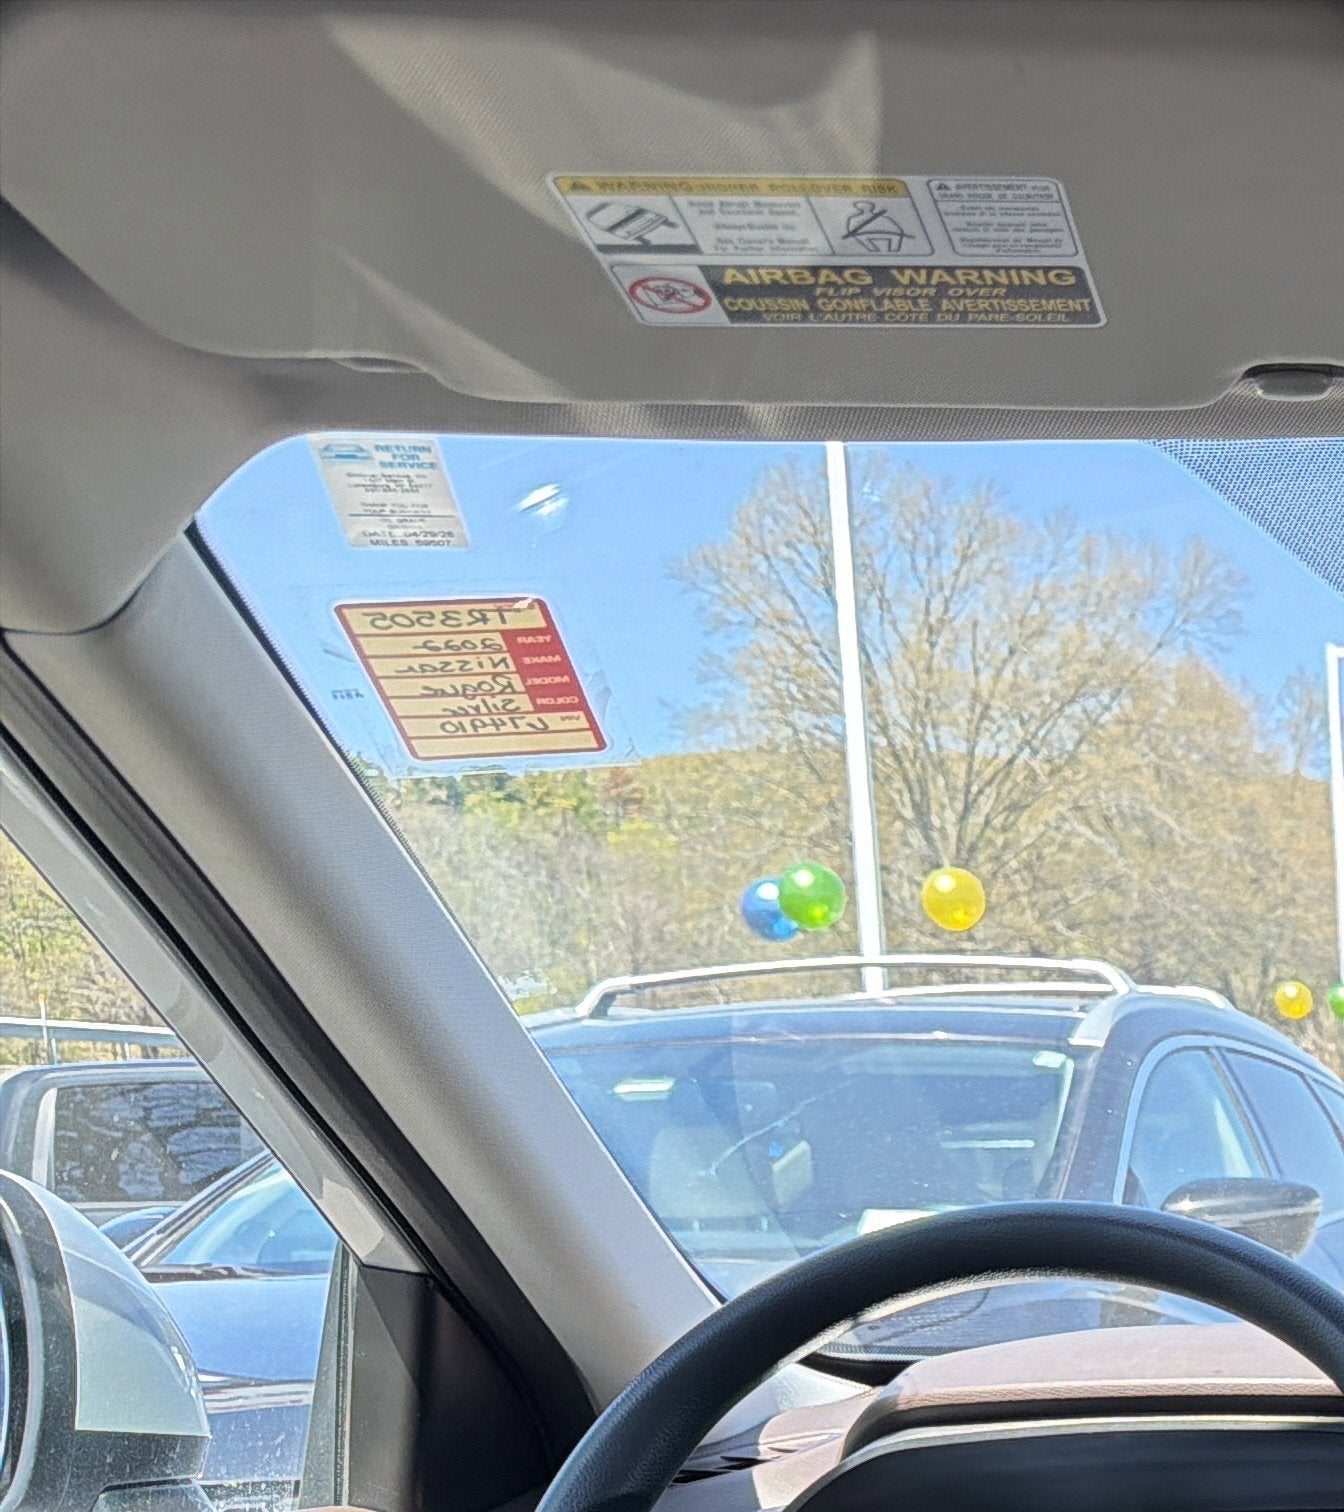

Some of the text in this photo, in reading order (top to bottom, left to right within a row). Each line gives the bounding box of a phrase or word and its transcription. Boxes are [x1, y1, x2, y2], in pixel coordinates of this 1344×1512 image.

[861, 182, 898, 195] RISK
[722, 268, 1077, 287] AIRBAG WARNING
[814, 287, 1008, 298] FLIP VISOR OVER
[723, 298, 1092, 313] COUSSIN GONFLABLE AVERTISSEMENT
[763, 312, 801, 322] VOIR
[809, 312, 877, 322] L'AUTRE
[936, 312, 960, 322] DU
[373, 444, 432, 454] RETURN
[391, 453, 420, 461] FOR
[378, 461, 438, 470] SERVICE
